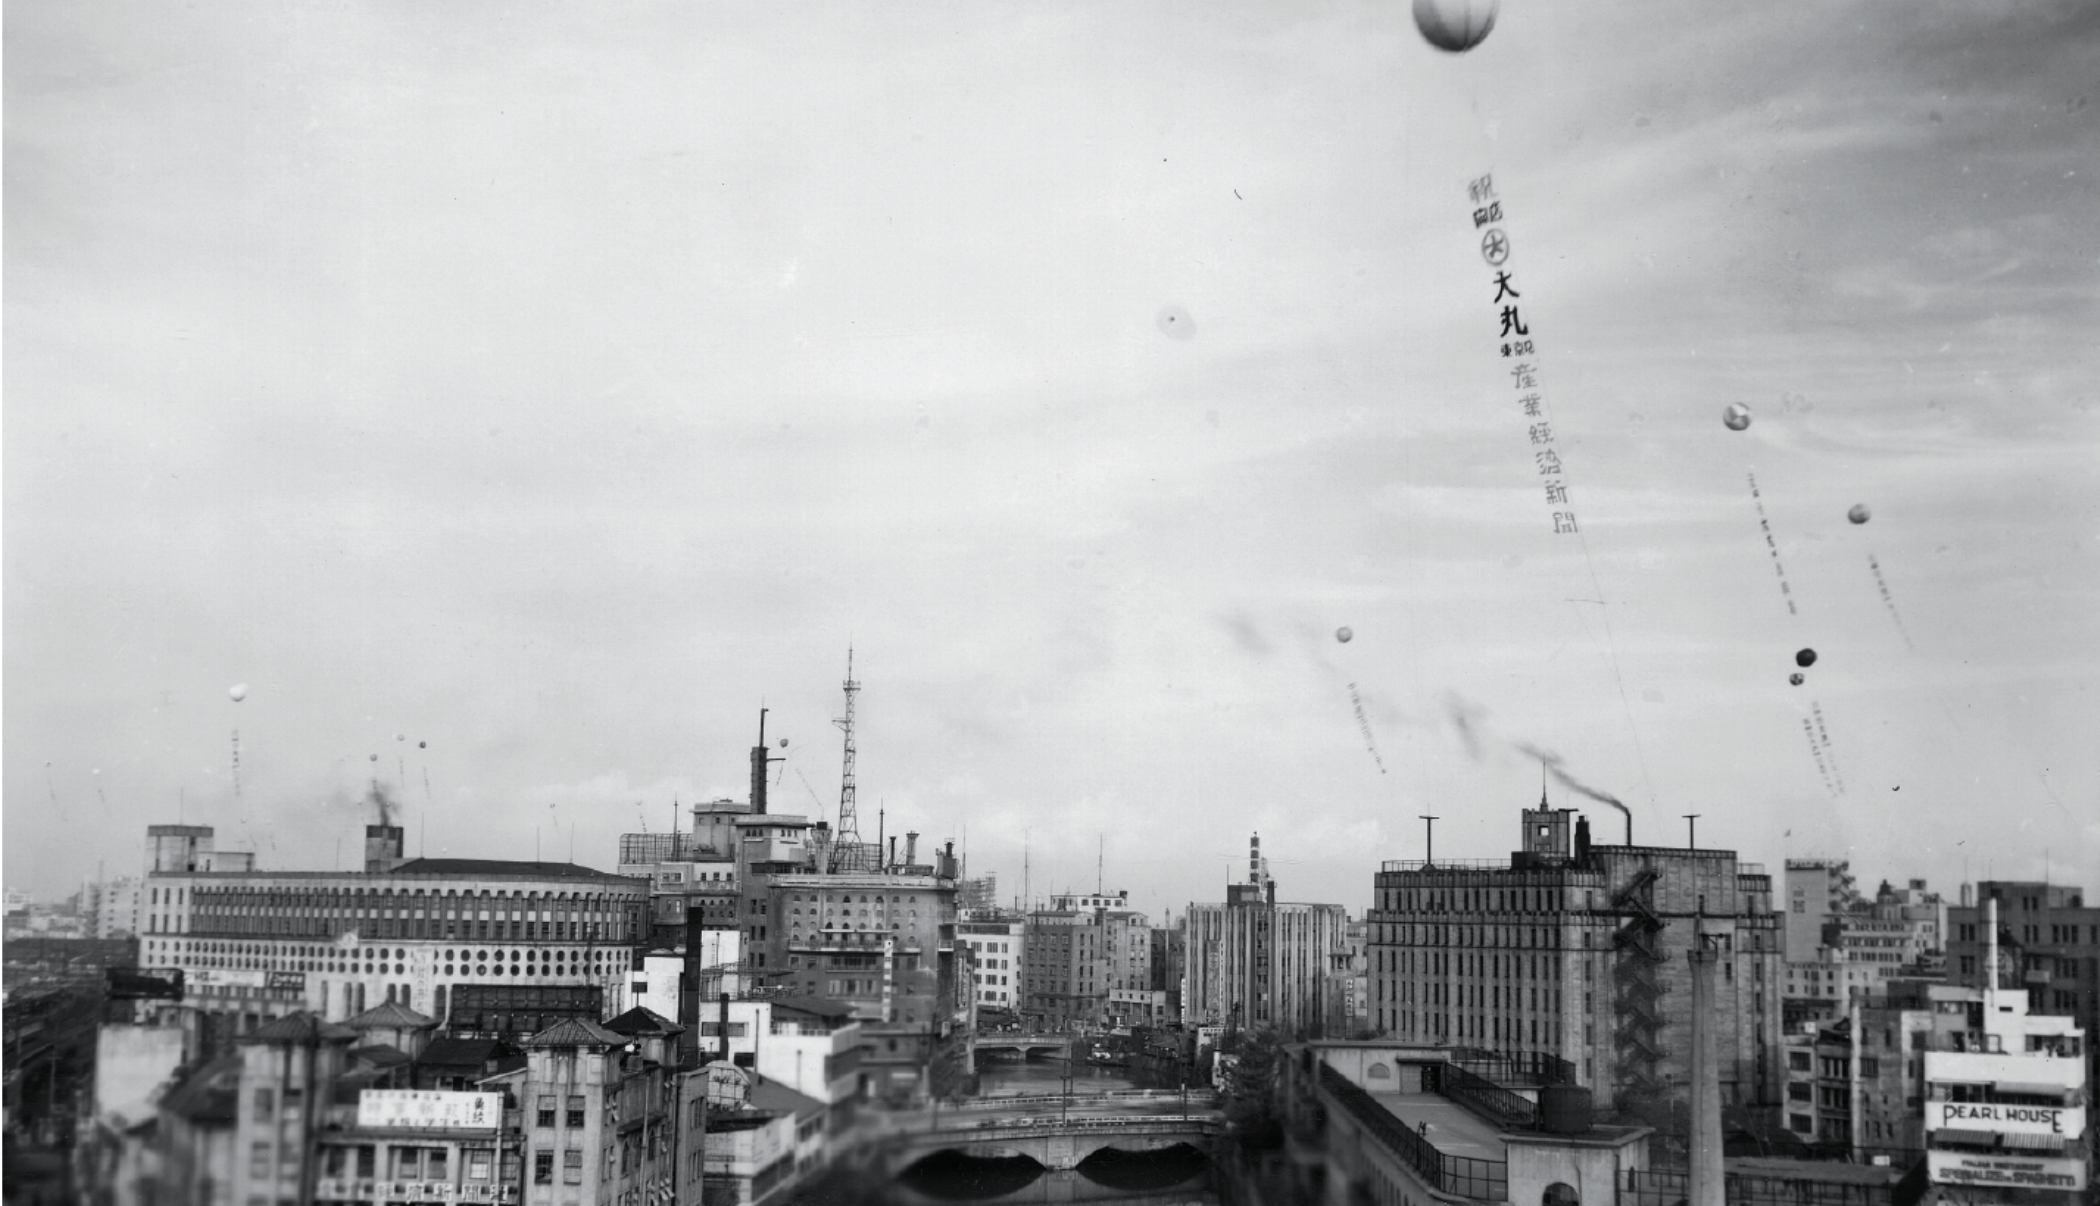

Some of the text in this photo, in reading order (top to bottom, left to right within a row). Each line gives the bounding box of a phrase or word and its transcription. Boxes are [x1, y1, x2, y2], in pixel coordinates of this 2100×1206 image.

[1493, 270, 1529, 338] 大丸
[1943, 1105, 2063, 1133] PEARL HOUSE
[2013, 1171, 2076, 1187] SPAGHETTI
